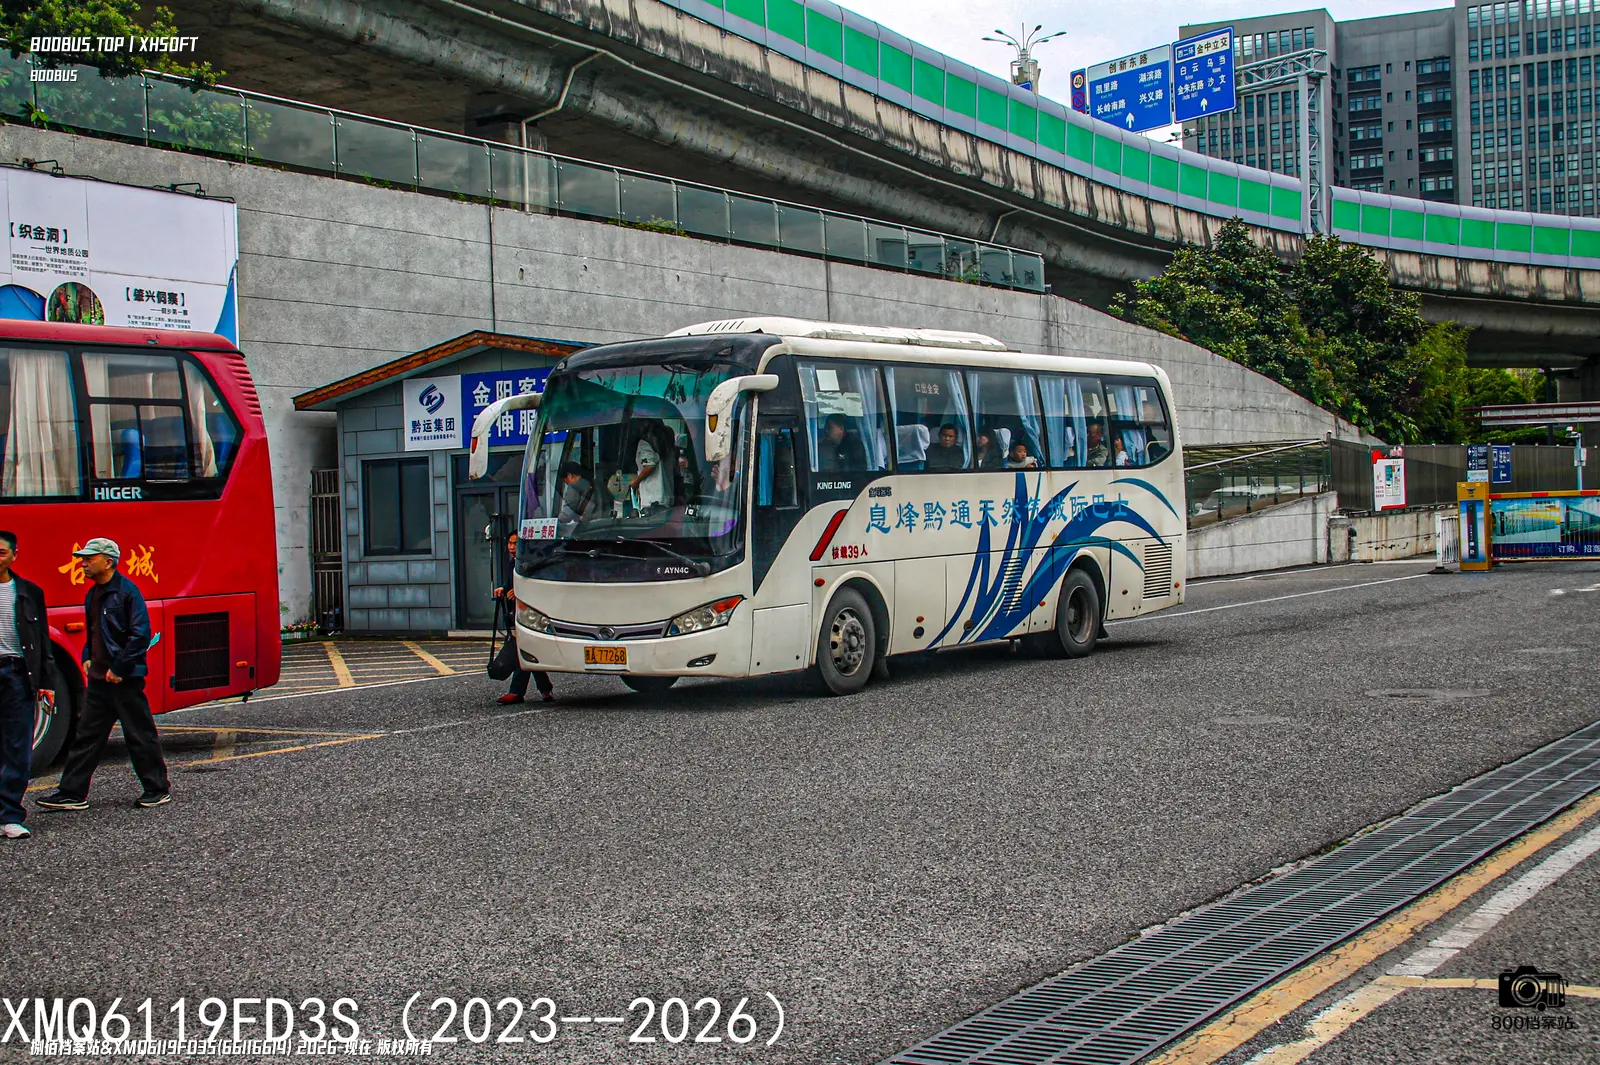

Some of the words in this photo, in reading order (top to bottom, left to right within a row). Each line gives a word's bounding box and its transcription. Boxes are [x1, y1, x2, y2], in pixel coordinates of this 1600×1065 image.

[1197, 37, 1228, 54] 金中立交
[1108, 53, 1148, 74] 创新东路
[1180, 62, 1199, 76] 白云
[1207, 55, 1226, 68] 乌当
[1095, 80, 1118, 95] 凯里路
[1207, 74, 1226, 87] 沙文
[1139, 88, 1164, 104] 兴义路
[1096, 98, 1126, 115] 长岭南路
[10, 222, 68, 243] 【织金洞】
[472, 377, 548, 407] 金阳客
[411, 417, 455, 434] 黔运集团
[94, 486, 143, 500] HIGER
[817, 482, 833, 490] KING
[833, 481, 852, 489] LONG
[866, 492, 1130, 534] 息烽黔通天然气城际巴士
[664, 566, 689, 574] AYN4C
